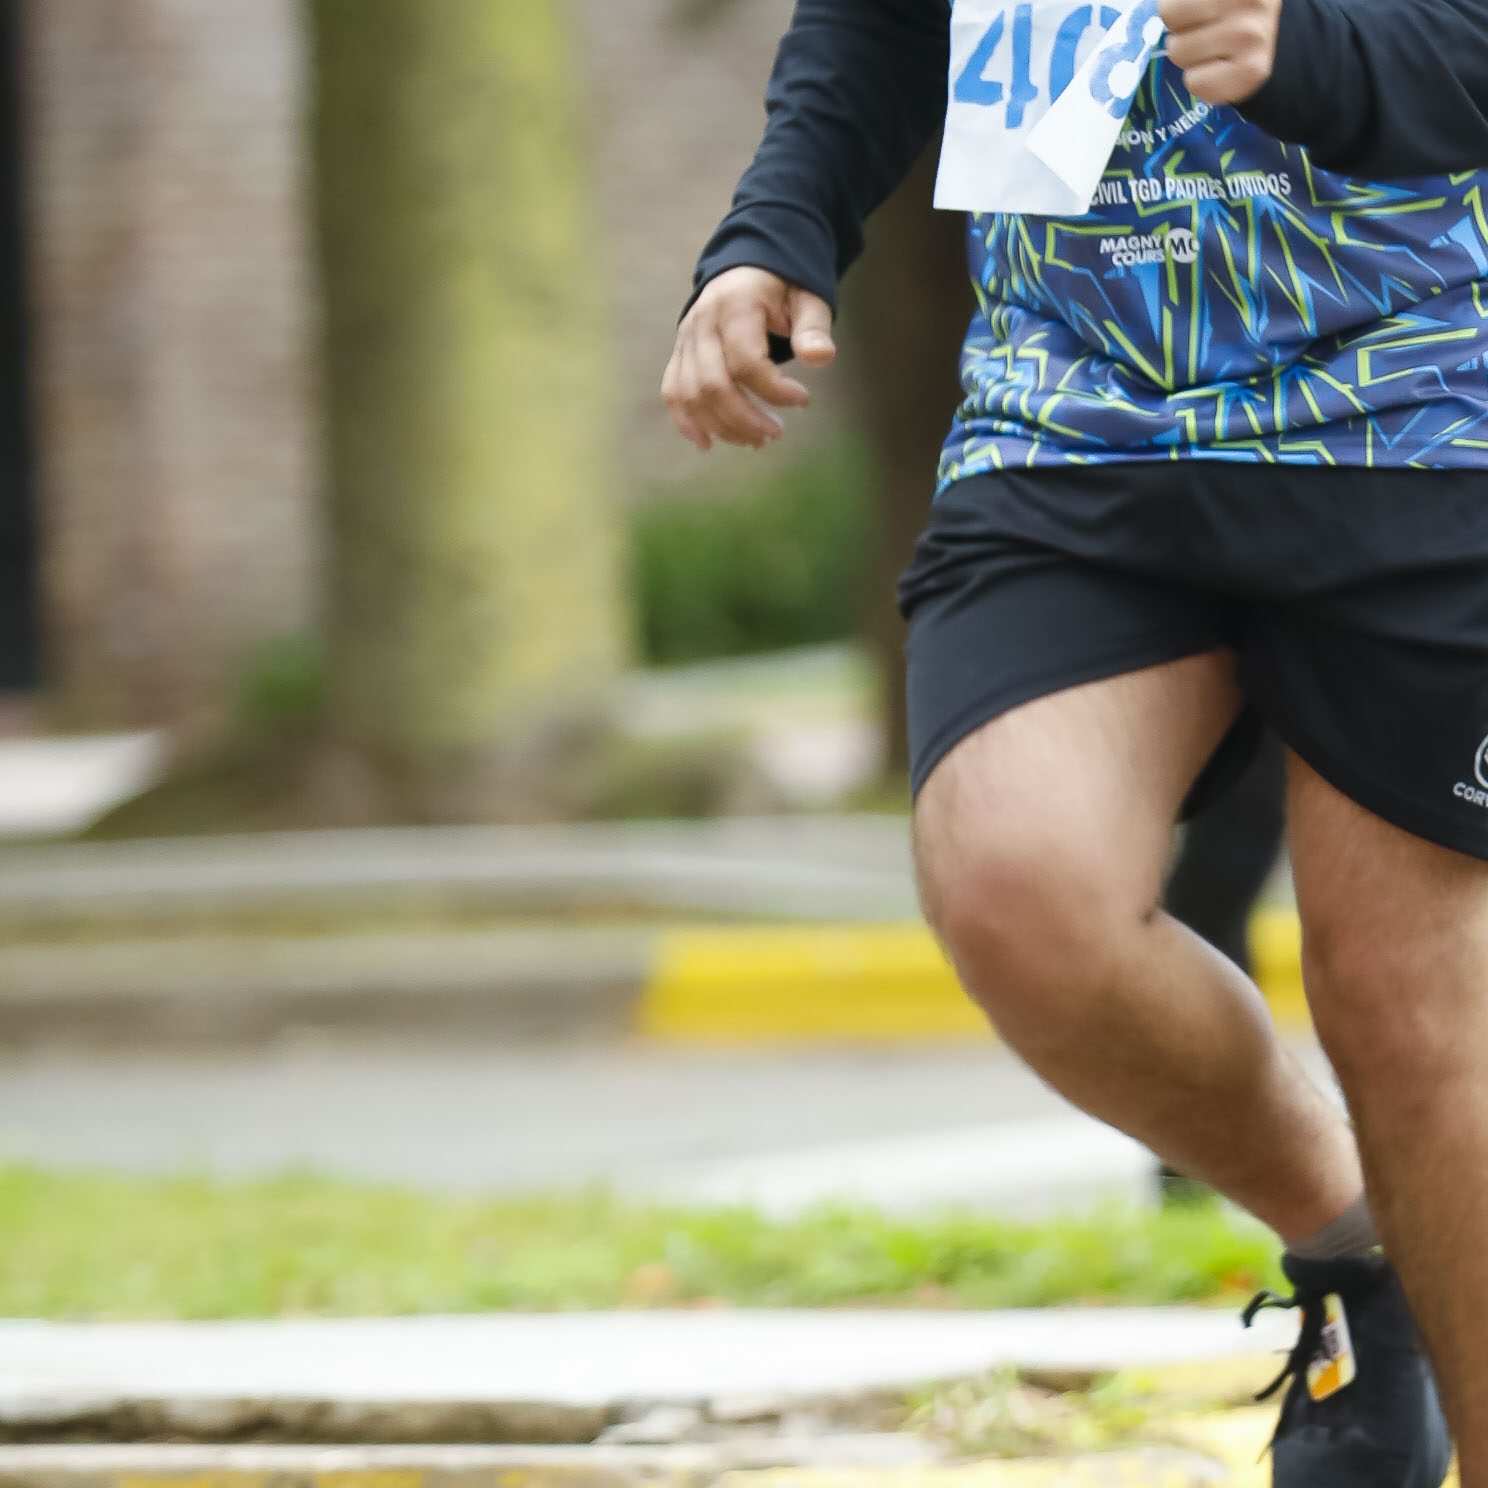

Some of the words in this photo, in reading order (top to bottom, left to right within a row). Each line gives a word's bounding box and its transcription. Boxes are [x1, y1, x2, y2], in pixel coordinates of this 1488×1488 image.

[1128, 177, 1163, 203] TGD
[1164, 175, 1226, 200] PADRES
[1227, 172, 1292, 199] UNIDOS
[1099, 234, 1164, 255] MAGNY
[1111, 247, 1167, 267] COURS
